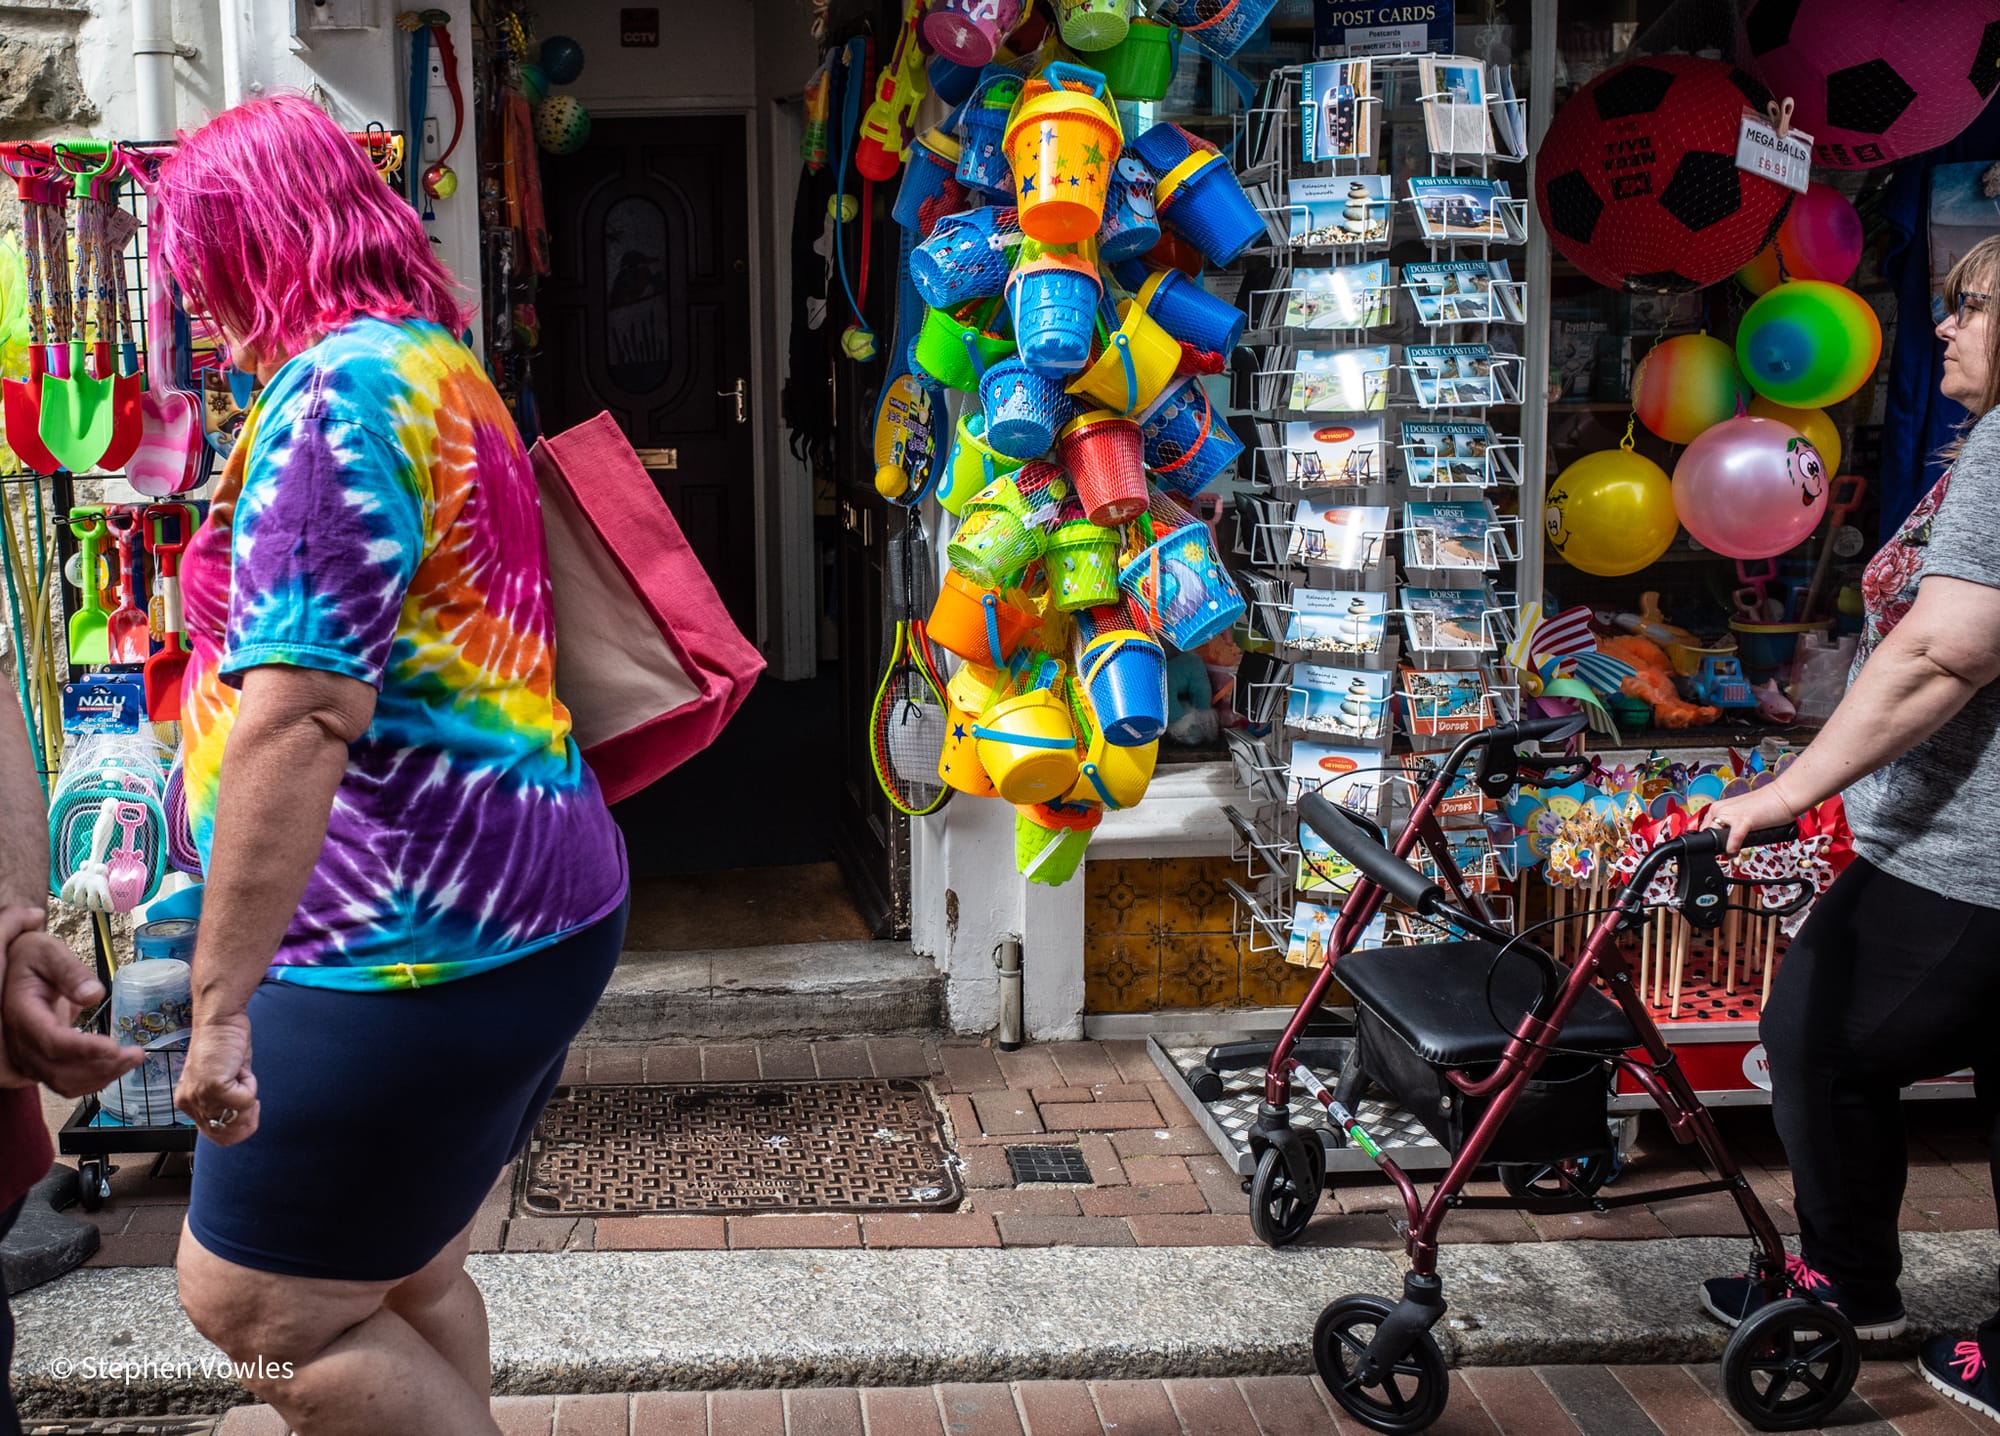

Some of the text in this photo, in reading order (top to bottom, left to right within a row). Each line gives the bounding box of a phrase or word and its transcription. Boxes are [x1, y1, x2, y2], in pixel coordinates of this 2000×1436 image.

[1332, 9, 1375, 27] POST
[1378, 4, 1436, 24] CARDS
[623, 31, 656, 42] CCTV
[1368, 29, 1401, 39] Postcards
[1304, 115, 1313, 134] YOU
[1305, 135, 1313, 156] WISH
[1746, 128, 1806, 161] MEGA BALLS
[1758, 157, 1787, 177] £6.99
[1471, 179, 1489, 187] HERE
[1410, 262, 1487, 273] DORSET COASTLINE
[1412, 346, 1486, 357] DORSET COASTLINE
[1410, 424, 1485, 434] DORSET COASTLINE
[1433, 508, 1464, 518] DORSET
[1430, 591, 1461, 600] DORSET
[78, 696, 126, 706] NALU
[1437, 721, 1469, 731] Dorset
[1441, 801, 1473, 814] Dorset
